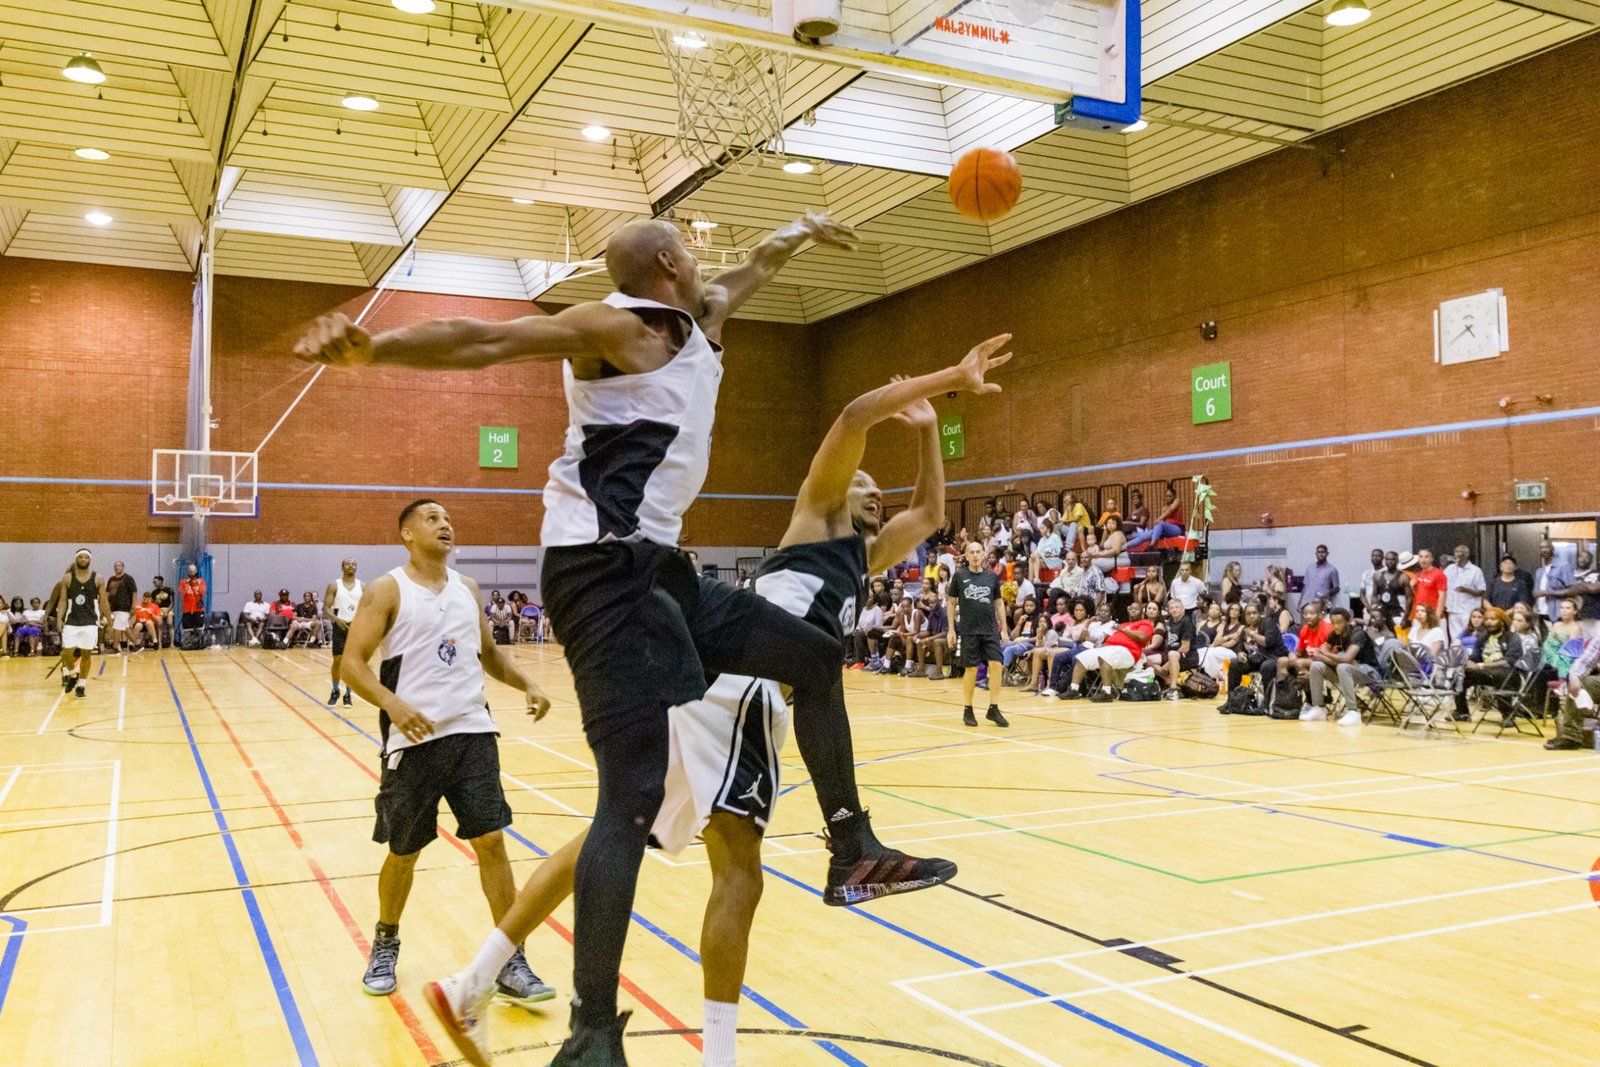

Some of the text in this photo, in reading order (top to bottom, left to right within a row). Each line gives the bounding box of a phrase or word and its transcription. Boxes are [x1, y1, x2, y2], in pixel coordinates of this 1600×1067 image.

[1195, 373, 1227, 392] Court
[1206, 397, 1215, 417] 6
[942, 423, 962, 436] Court
[488, 432, 509, 443] Hall
[949, 440, 955, 455] 5
[492, 449, 503, 463] 2
